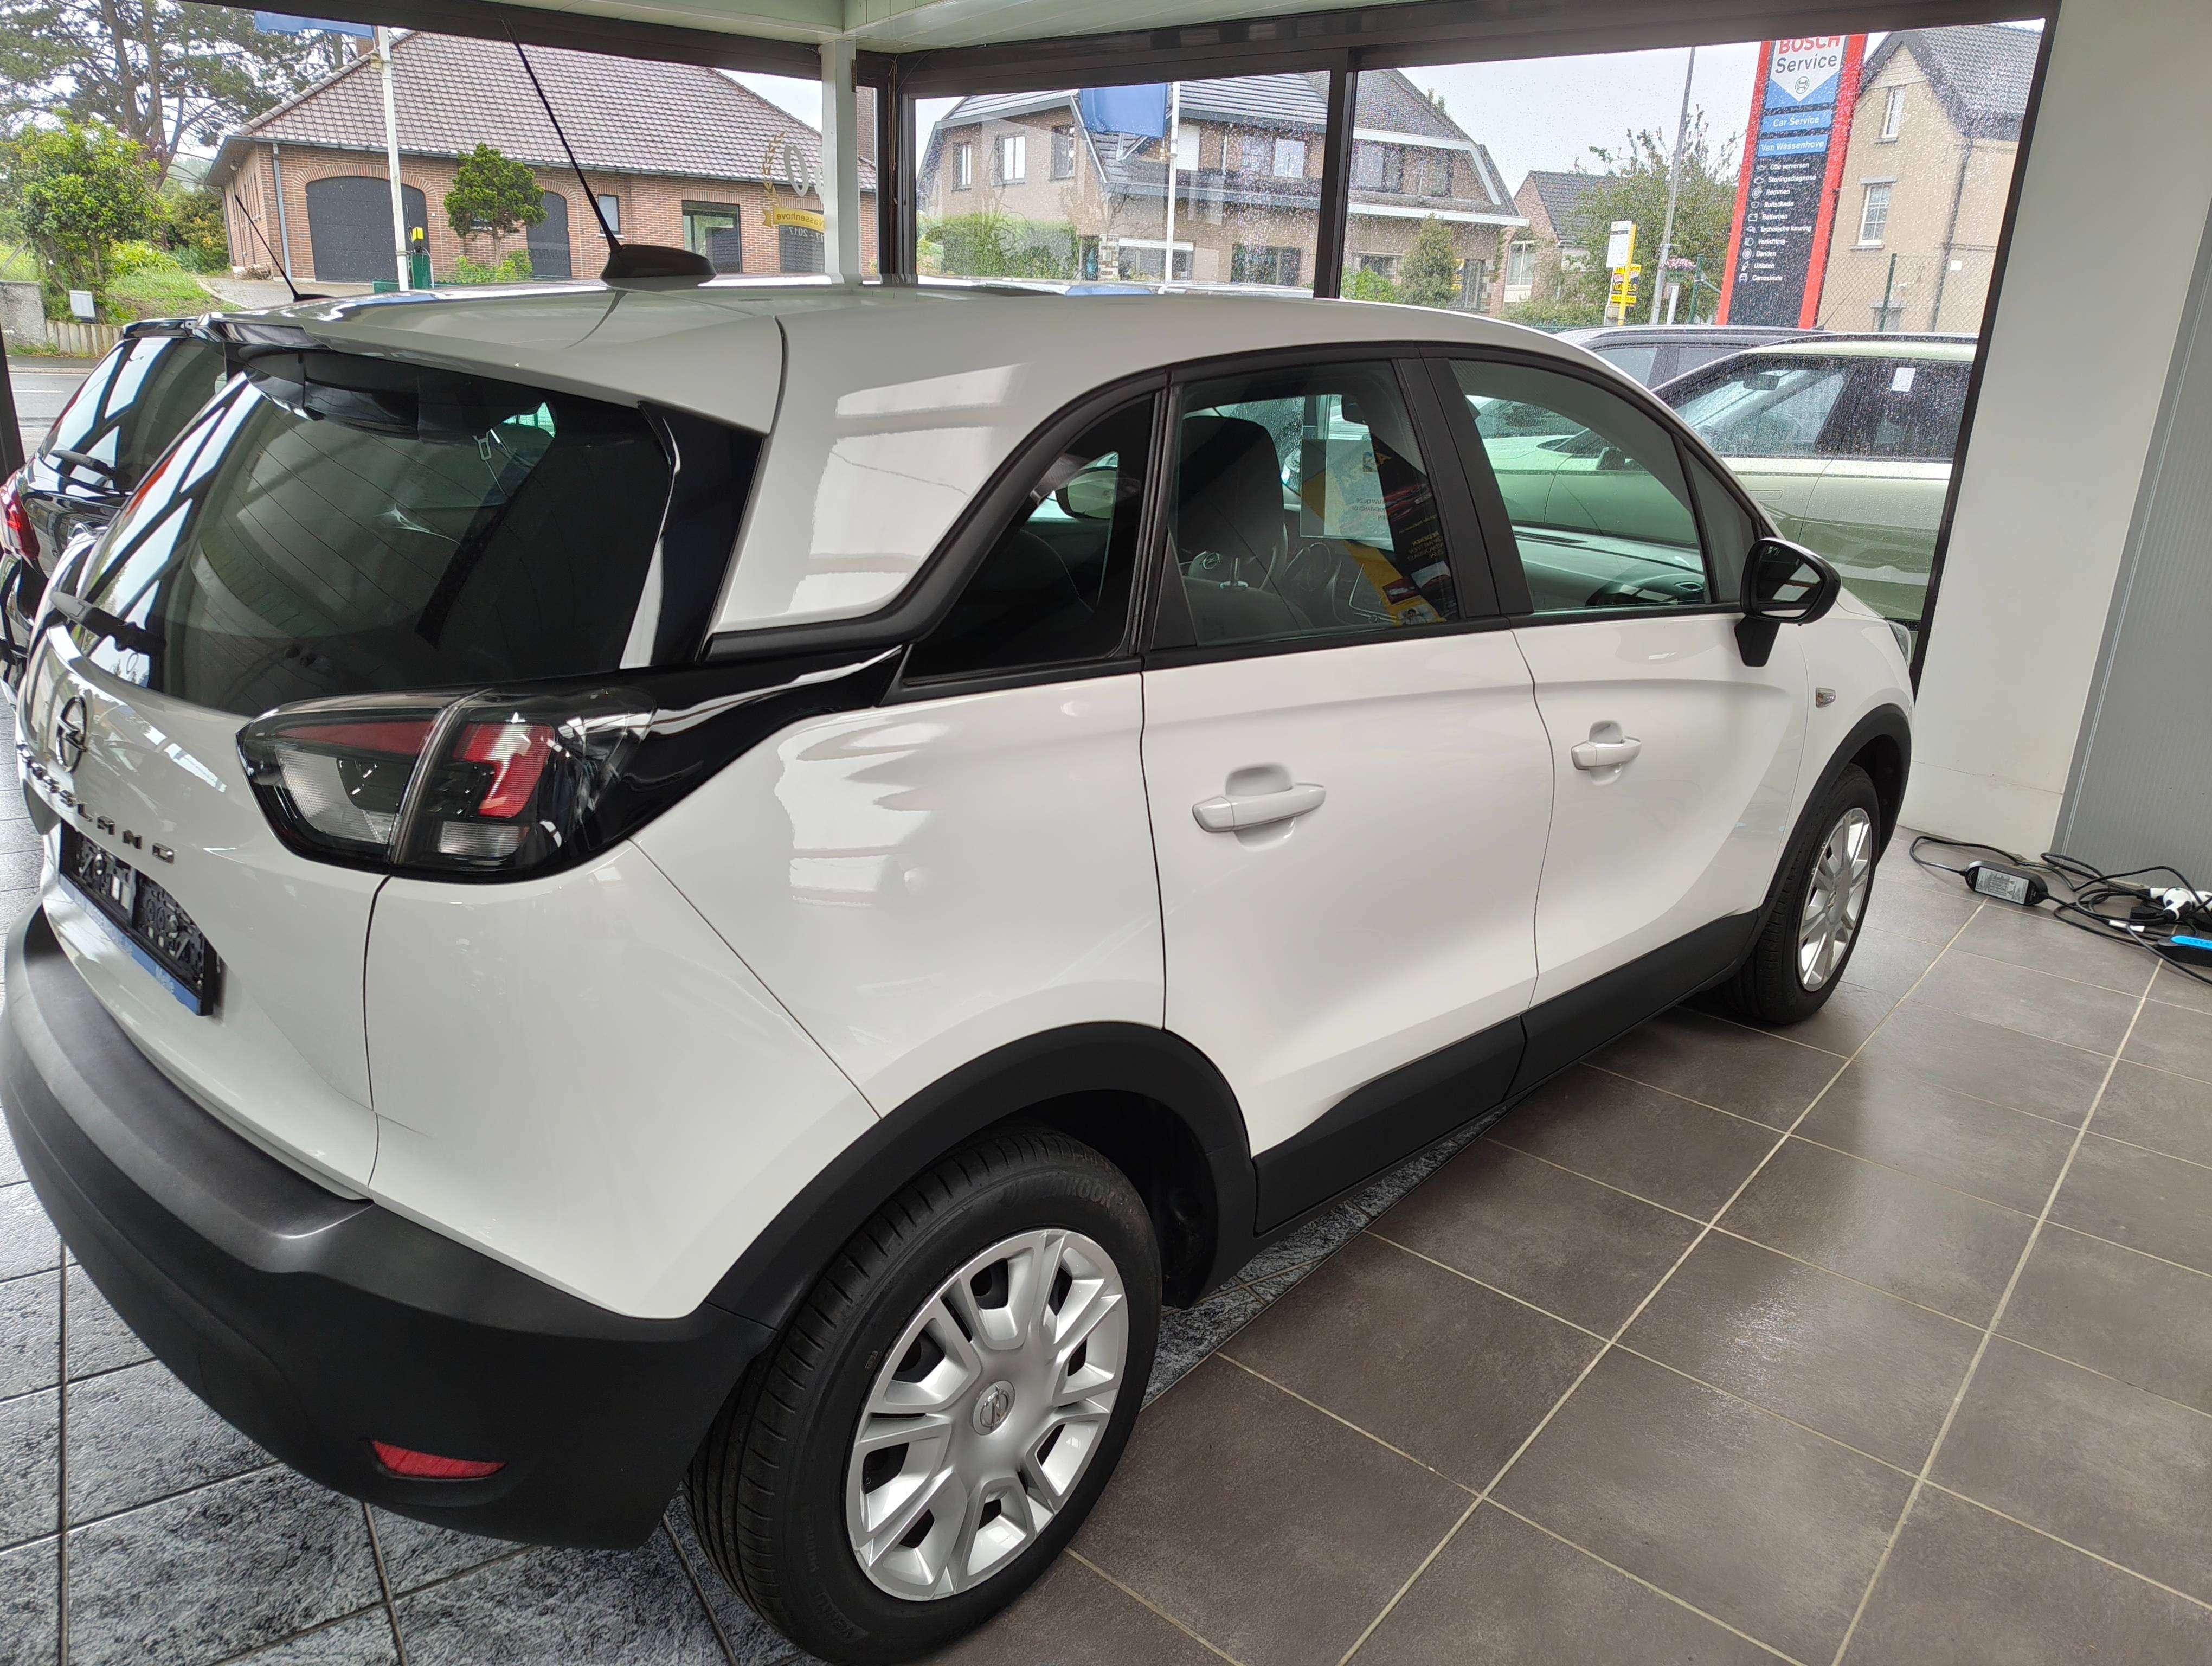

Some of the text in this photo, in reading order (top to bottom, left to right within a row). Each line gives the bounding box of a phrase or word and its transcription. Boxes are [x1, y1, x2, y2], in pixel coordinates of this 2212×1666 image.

[1778, 36, 1841, 54] BOSCH
[1775, 53, 1837, 73] Service
[1773, 116, 1820, 127] Car Service
[1776, 140, 1825, 150] Wassenhove
